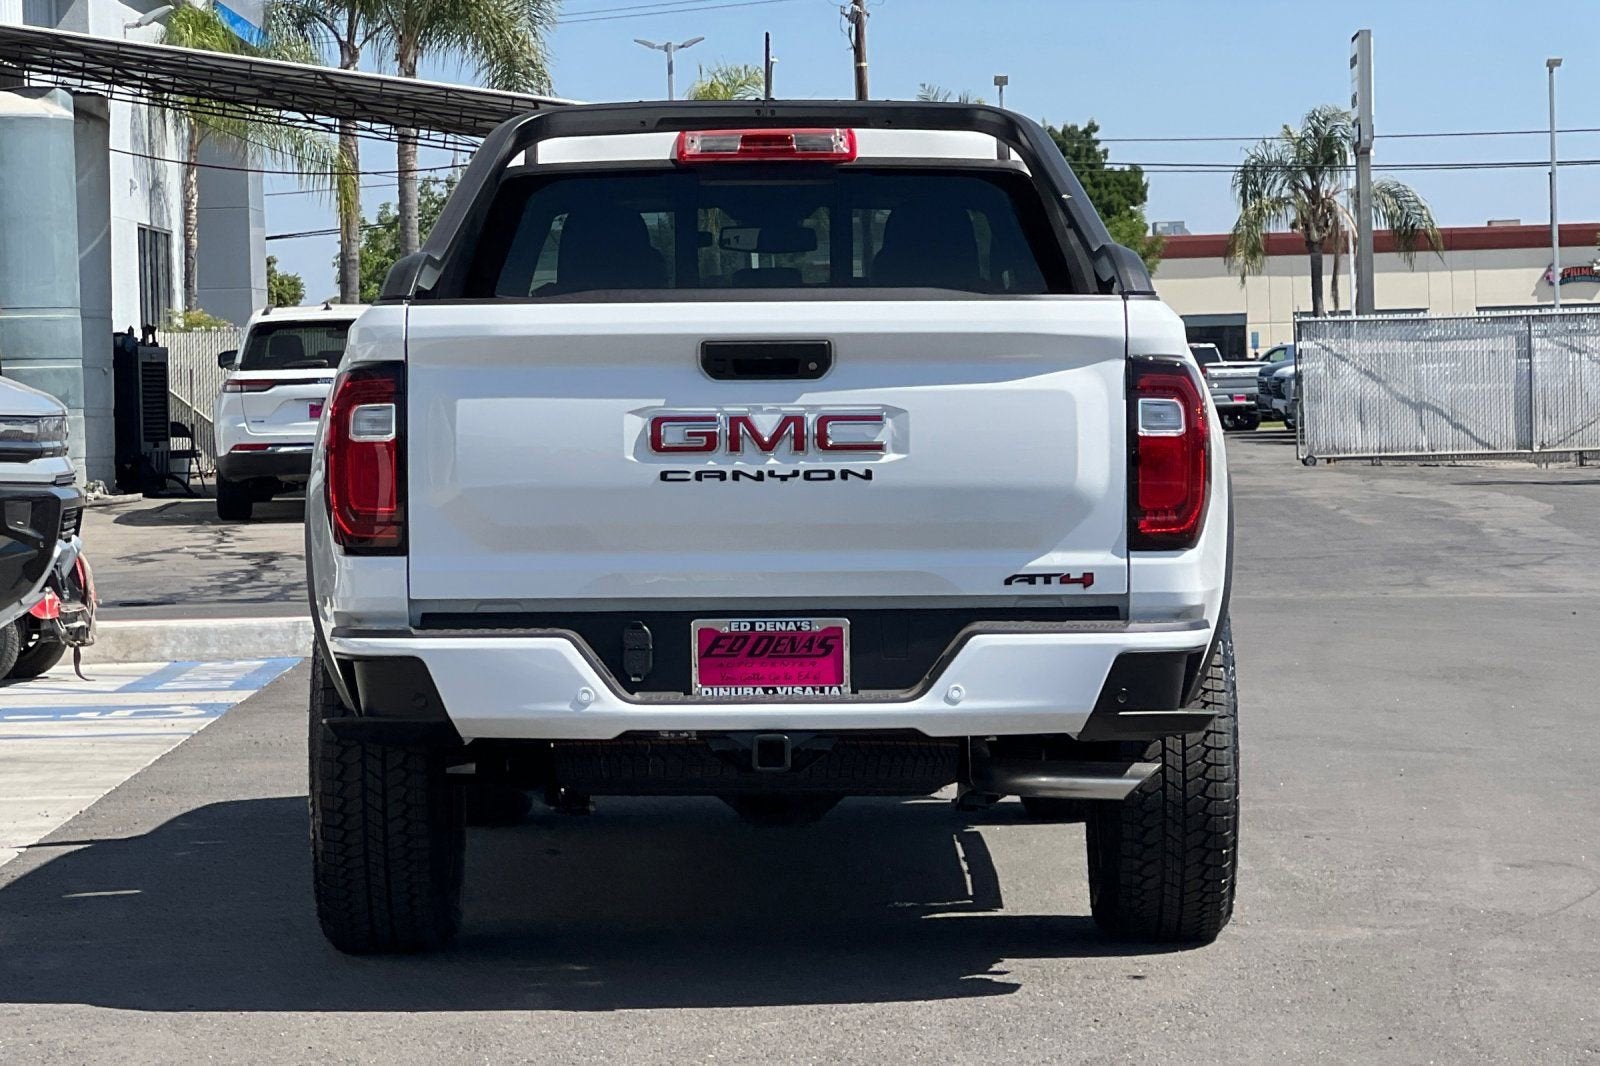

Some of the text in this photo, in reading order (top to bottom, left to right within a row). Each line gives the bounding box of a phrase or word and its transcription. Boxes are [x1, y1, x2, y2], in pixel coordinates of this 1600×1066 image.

[649, 411, 887, 455] GMC
[660, 469, 873, 482] CANYON
[1004, 572, 1094, 589] AT4
[730, 621, 810, 632] ED DENA'S
[702, 635, 750, 658] ED
[702, 686, 841, 696] DINUBA VISALIA
